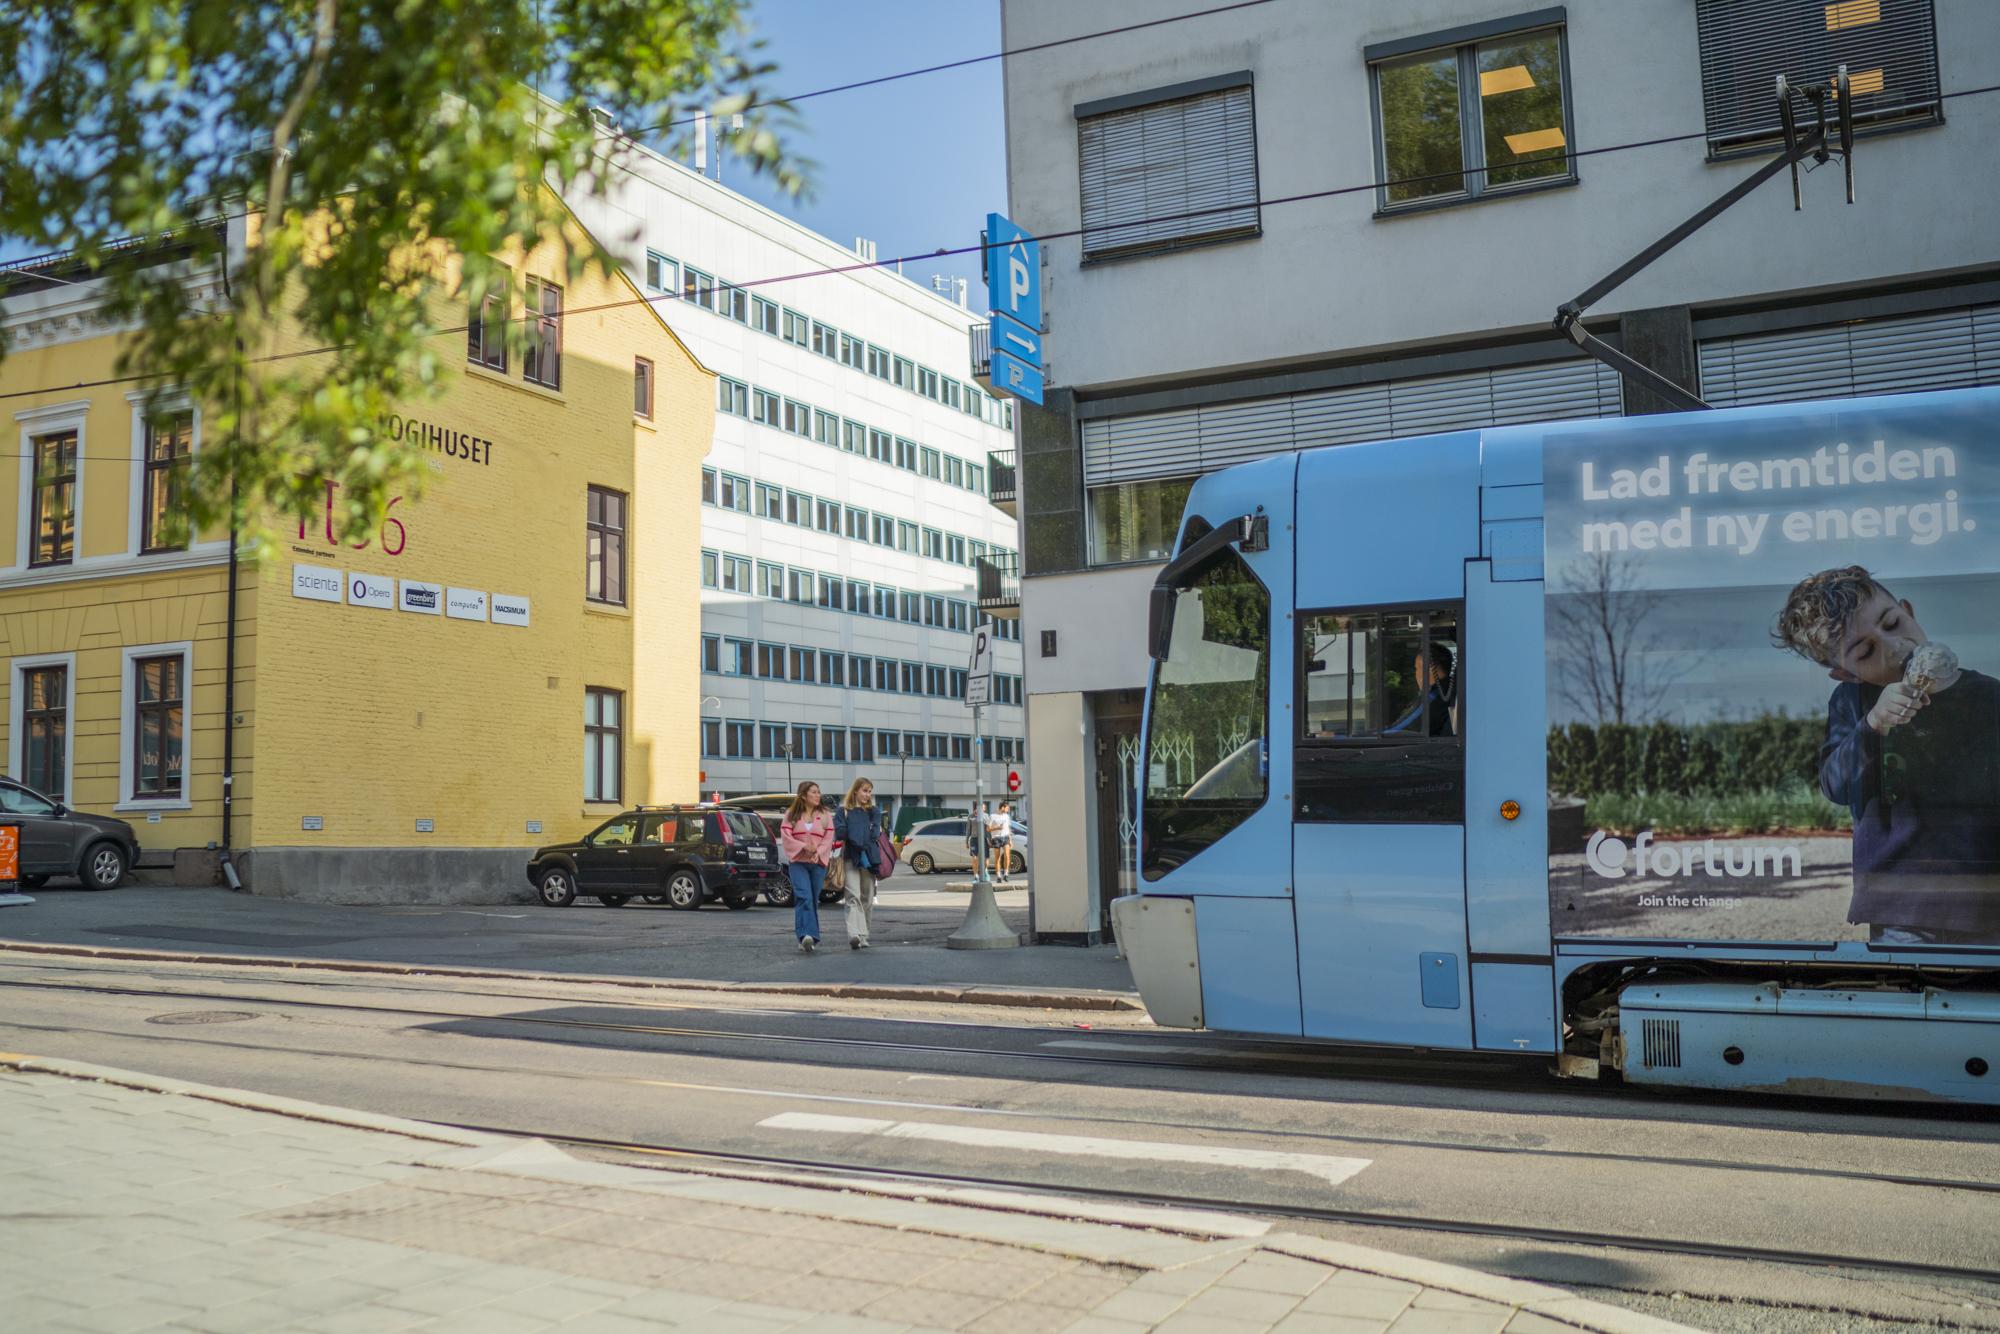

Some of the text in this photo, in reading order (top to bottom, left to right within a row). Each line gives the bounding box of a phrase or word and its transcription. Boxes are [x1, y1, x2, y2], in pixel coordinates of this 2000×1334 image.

[1010, 255, 1029, 313] P
[1582, 440, 1957, 500] Lad fremtiden
[1583, 489, 1977, 555] med ny energi.
[298, 575, 338, 592] scienta
[367, 586, 390, 598] Opera
[495, 604, 526, 615] MACSIMUM
[974, 632, 987, 670] P
[1632, 831, 1802, 877] fortum
[1638, 895, 1742, 910] Join the change
